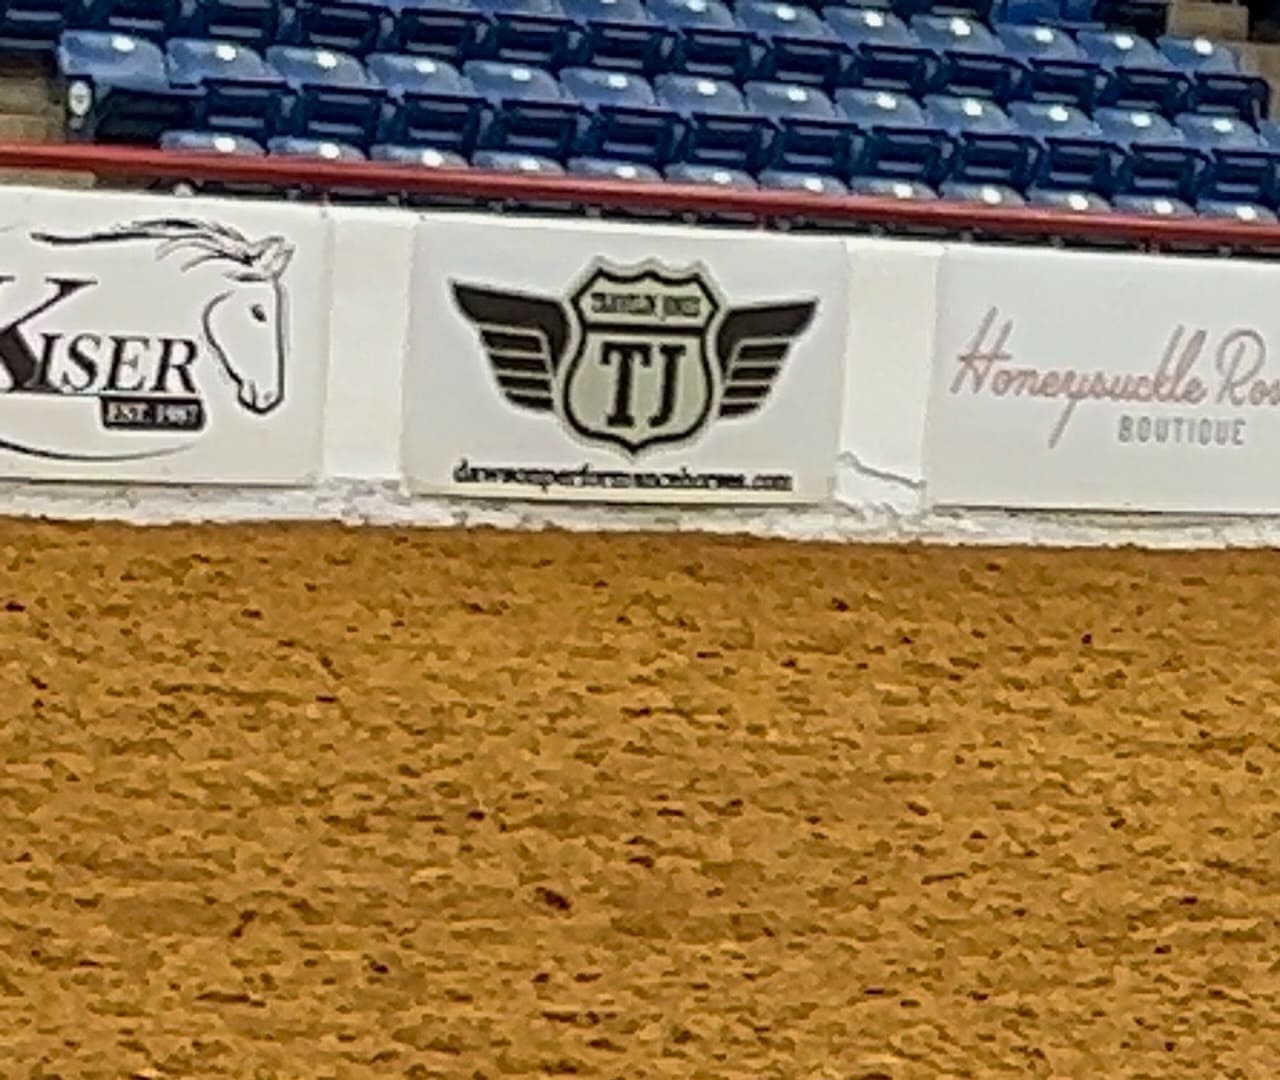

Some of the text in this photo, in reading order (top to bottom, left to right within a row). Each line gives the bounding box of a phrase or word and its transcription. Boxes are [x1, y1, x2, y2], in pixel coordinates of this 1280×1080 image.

[601, 341, 687, 429] TJ
[950, 305, 1207, 449] Honeysuckle
[1118, 416, 1246, 447] BOUTIQUE
